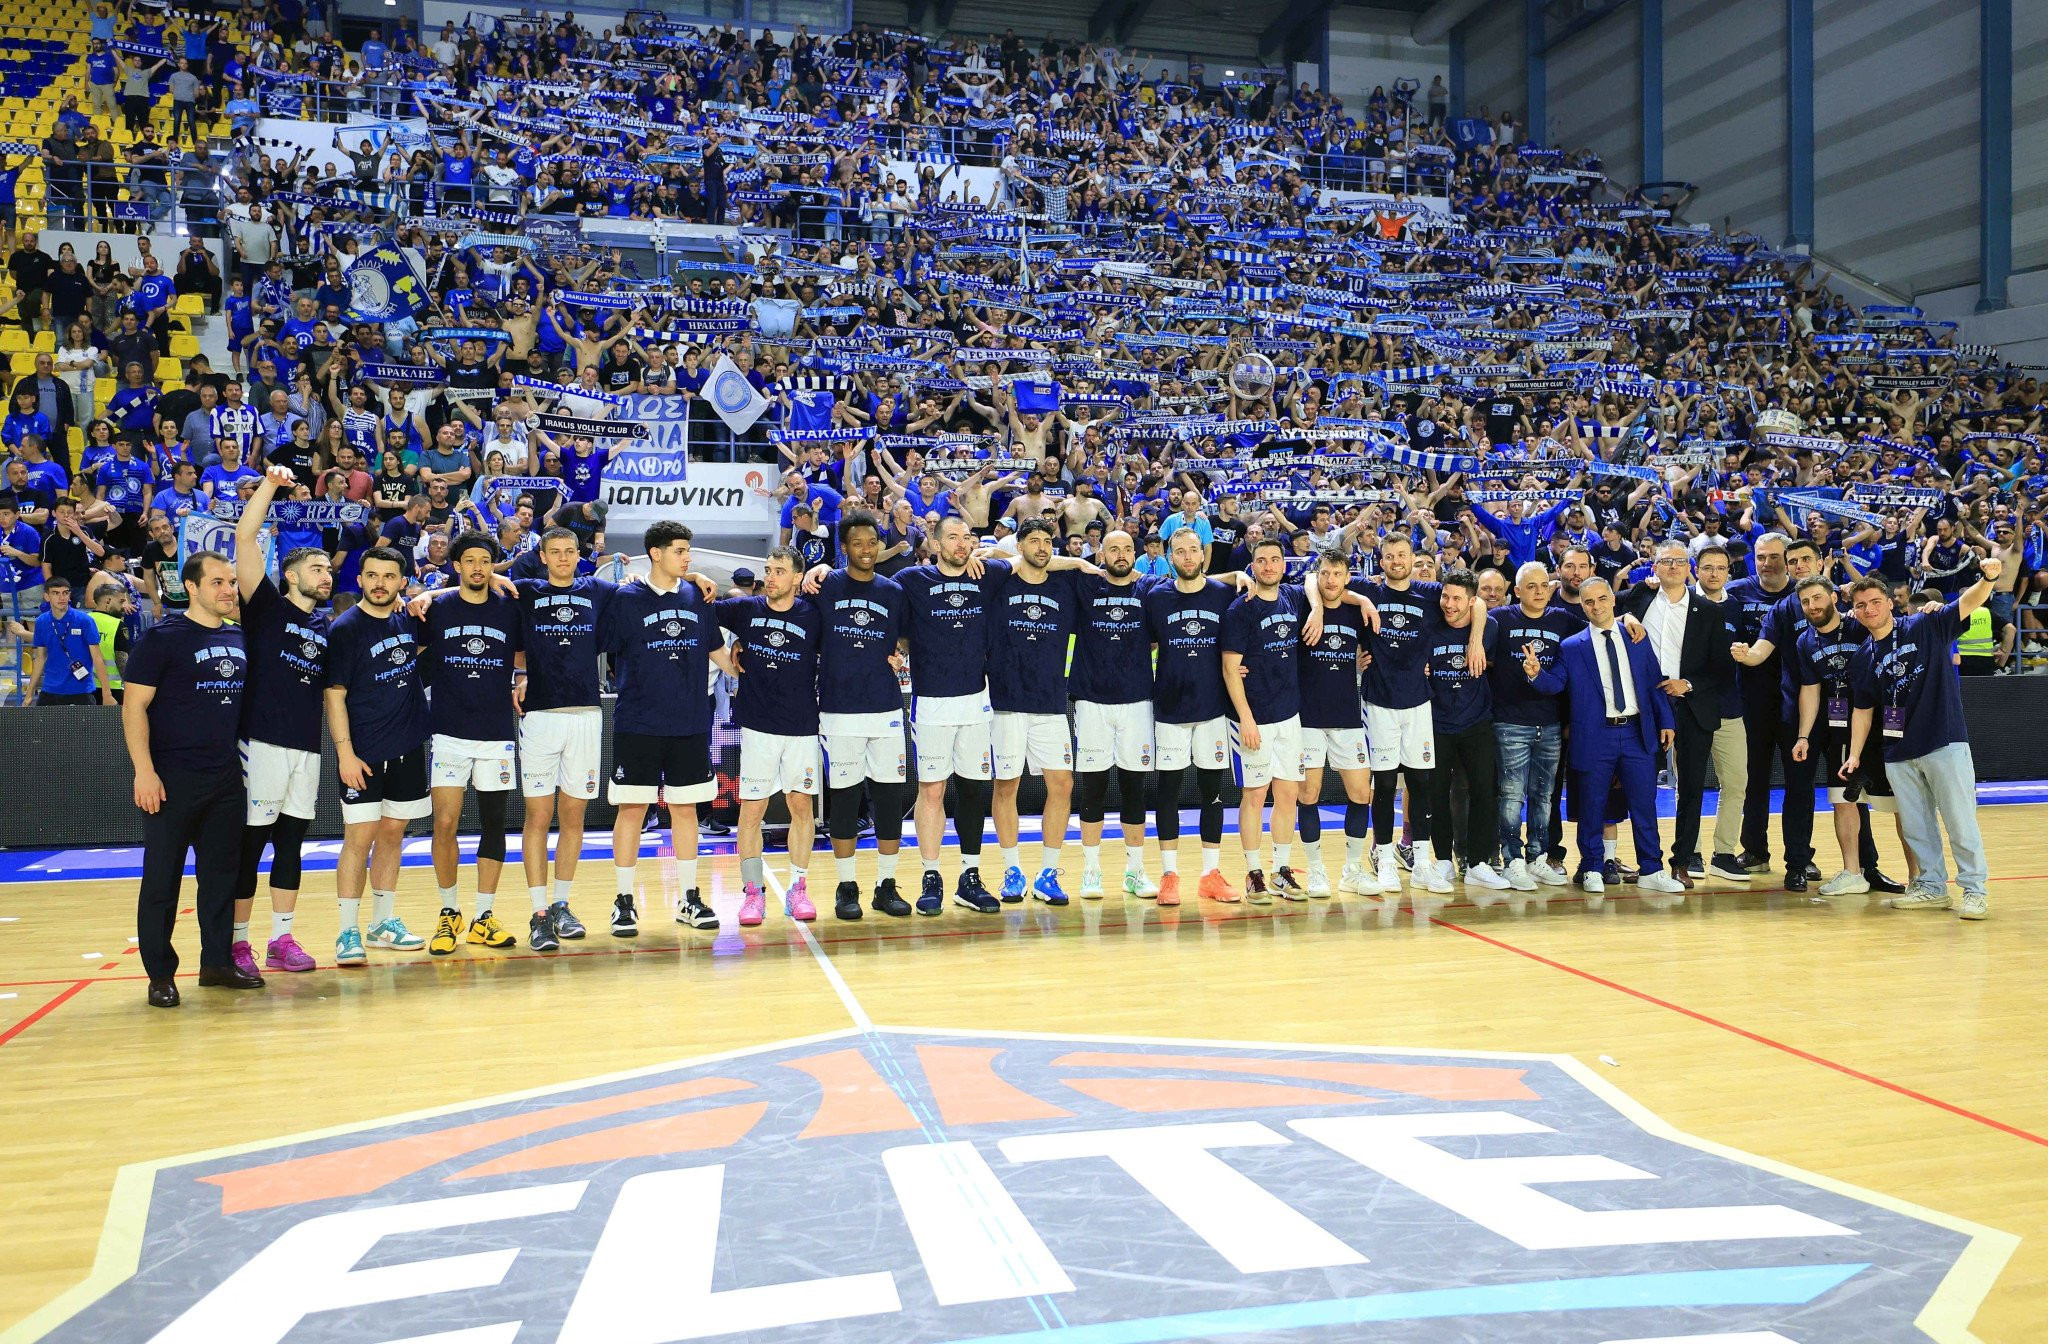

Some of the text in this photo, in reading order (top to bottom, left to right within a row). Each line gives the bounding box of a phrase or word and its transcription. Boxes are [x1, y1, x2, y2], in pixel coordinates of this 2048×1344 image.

[835, 86, 877, 95] ΗΡΑΚΛΗΣ
[595, 170, 650, 180] ΗΡΑΚΛΗΣ
[930, 270, 992, 283] ΗΡΑΚΛΗΣ
[1244, 267, 1278, 276] ΗΡΑΚΛΗΣ
[1349, 277, 1363, 292] 10
[1552, 276, 1604, 290] ΗΡΑΚΛΗΣ
[1077, 293, 1137, 304] ΗΡΑΚΛΗΣ
[1431, 312, 1465, 321] ΡΑΚΛΗΣ
[689, 321, 738, 330] ΗΡΑΚΛΗΣ
[970, 351, 1039, 360] FC ΗΡΑΚΛΗΣ
[860, 363, 916, 371] ΗΡΑΚΛΗΣ
[1459, 366, 1509, 375] ΗΡΑΚΛΗΣ
[377, 367, 435, 379] ΗΡΑΚΛΗΣ
[1510, 381, 1528, 389] IRAKLIS
[1550, 380, 1563, 388] CLUB
[545, 420, 575, 430] IRAKLIS
[576, 423, 606, 433] VOLLEY
[607, 425, 628, 434] CLUB
[784, 428, 864, 439] ΗΡΑΚΛΗΣ
[1115, 428, 1173, 440] ΗΡΑΚΛΗ
[1768, 435, 1834, 449] ΗΡΑΚΛΗΣ
[1188, 459, 1217, 468] FORZA
[1248, 455, 1326, 472] ΗΡΑΚΛΗ
[498, 479, 552, 487] ΗΡΑΚΛΗΣ
[386, 491, 400, 501] 34
[306, 504, 336, 517] ΗΡΑ
[931, 606, 982, 617] ΗΡΑΚΛΗΣ
[1009, 619, 1058, 631] ΗΡΑΚΛΗΣ
[1092, 620, 1141, 630] ΗΡΑΚΛΗΣ
[1970, 618, 1987, 626] URITY
[535, 624, 592, 632] ΗΡΑΚΛΗΣ
[834, 625, 886, 639] ΗΡΑΚΛΗΣ
[1379, 627, 1418, 638] ΡΑΚΛΗΣ
[647, 639, 698, 649] ΗΡΑΚΛΗΣ
[1168, 637, 1217, 646] ΗΡΑΚΛΗΣ
[1263, 636, 1299, 650] ΗΡΑΚΛΗΣ
[748, 642, 801, 661] ΗΡΑΚΛΗΣ
[1310, 651, 1355, 660] ΗΡΑΚΛΗΣ
[1510, 651, 1554, 662] ΗΡΛΗ
[280, 650, 322, 673] ΗΡΑΚΛΗ
[444, 655, 504, 667] ΗΡΑΚΛΗΣ
[375, 659, 416, 681] ΗΡΑΚΛΗ
[1433, 669, 1470, 677] ΗΡΑΚΛ
[196, 680, 244, 690] ΗΡΑΚΛΗ
[145, 1111, 1863, 1344] ELITE
